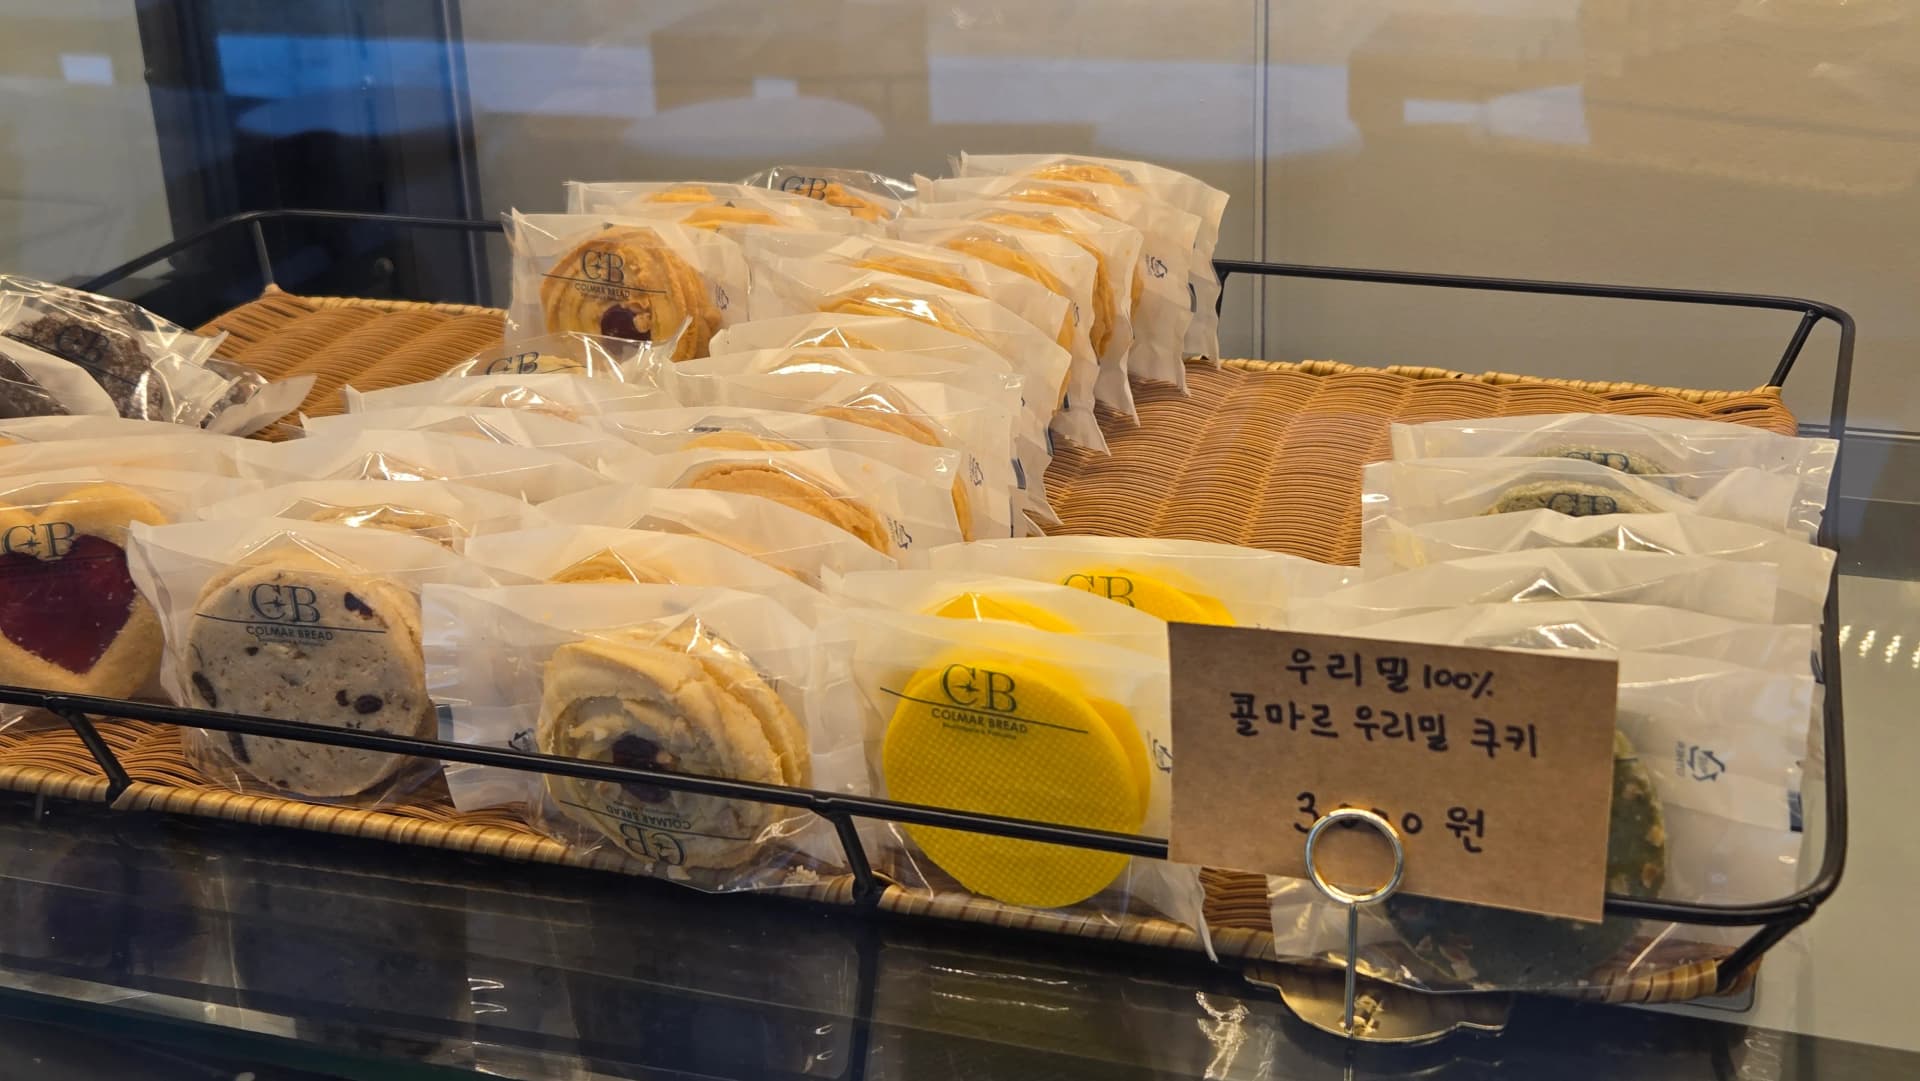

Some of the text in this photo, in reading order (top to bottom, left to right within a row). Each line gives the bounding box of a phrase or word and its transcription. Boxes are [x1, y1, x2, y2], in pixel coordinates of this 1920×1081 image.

[582, 249, 625, 285] CB
[2, 521, 76, 561] CB
[251, 583, 321, 624] CB
[246, 625, 334, 641] COLMAR BREAD
[941, 663, 1018, 714] CB
[1422, 663, 1495, 699] 100%
[931, 707, 985, 726] COLMAR
[987, 717, 1029, 734] BREAD
[1229, 692, 1537, 759] 콜마르 우리밀 쿠키
[641, 814, 692, 830] COLMAR
[1294, 792, 1485, 853] 30 원
